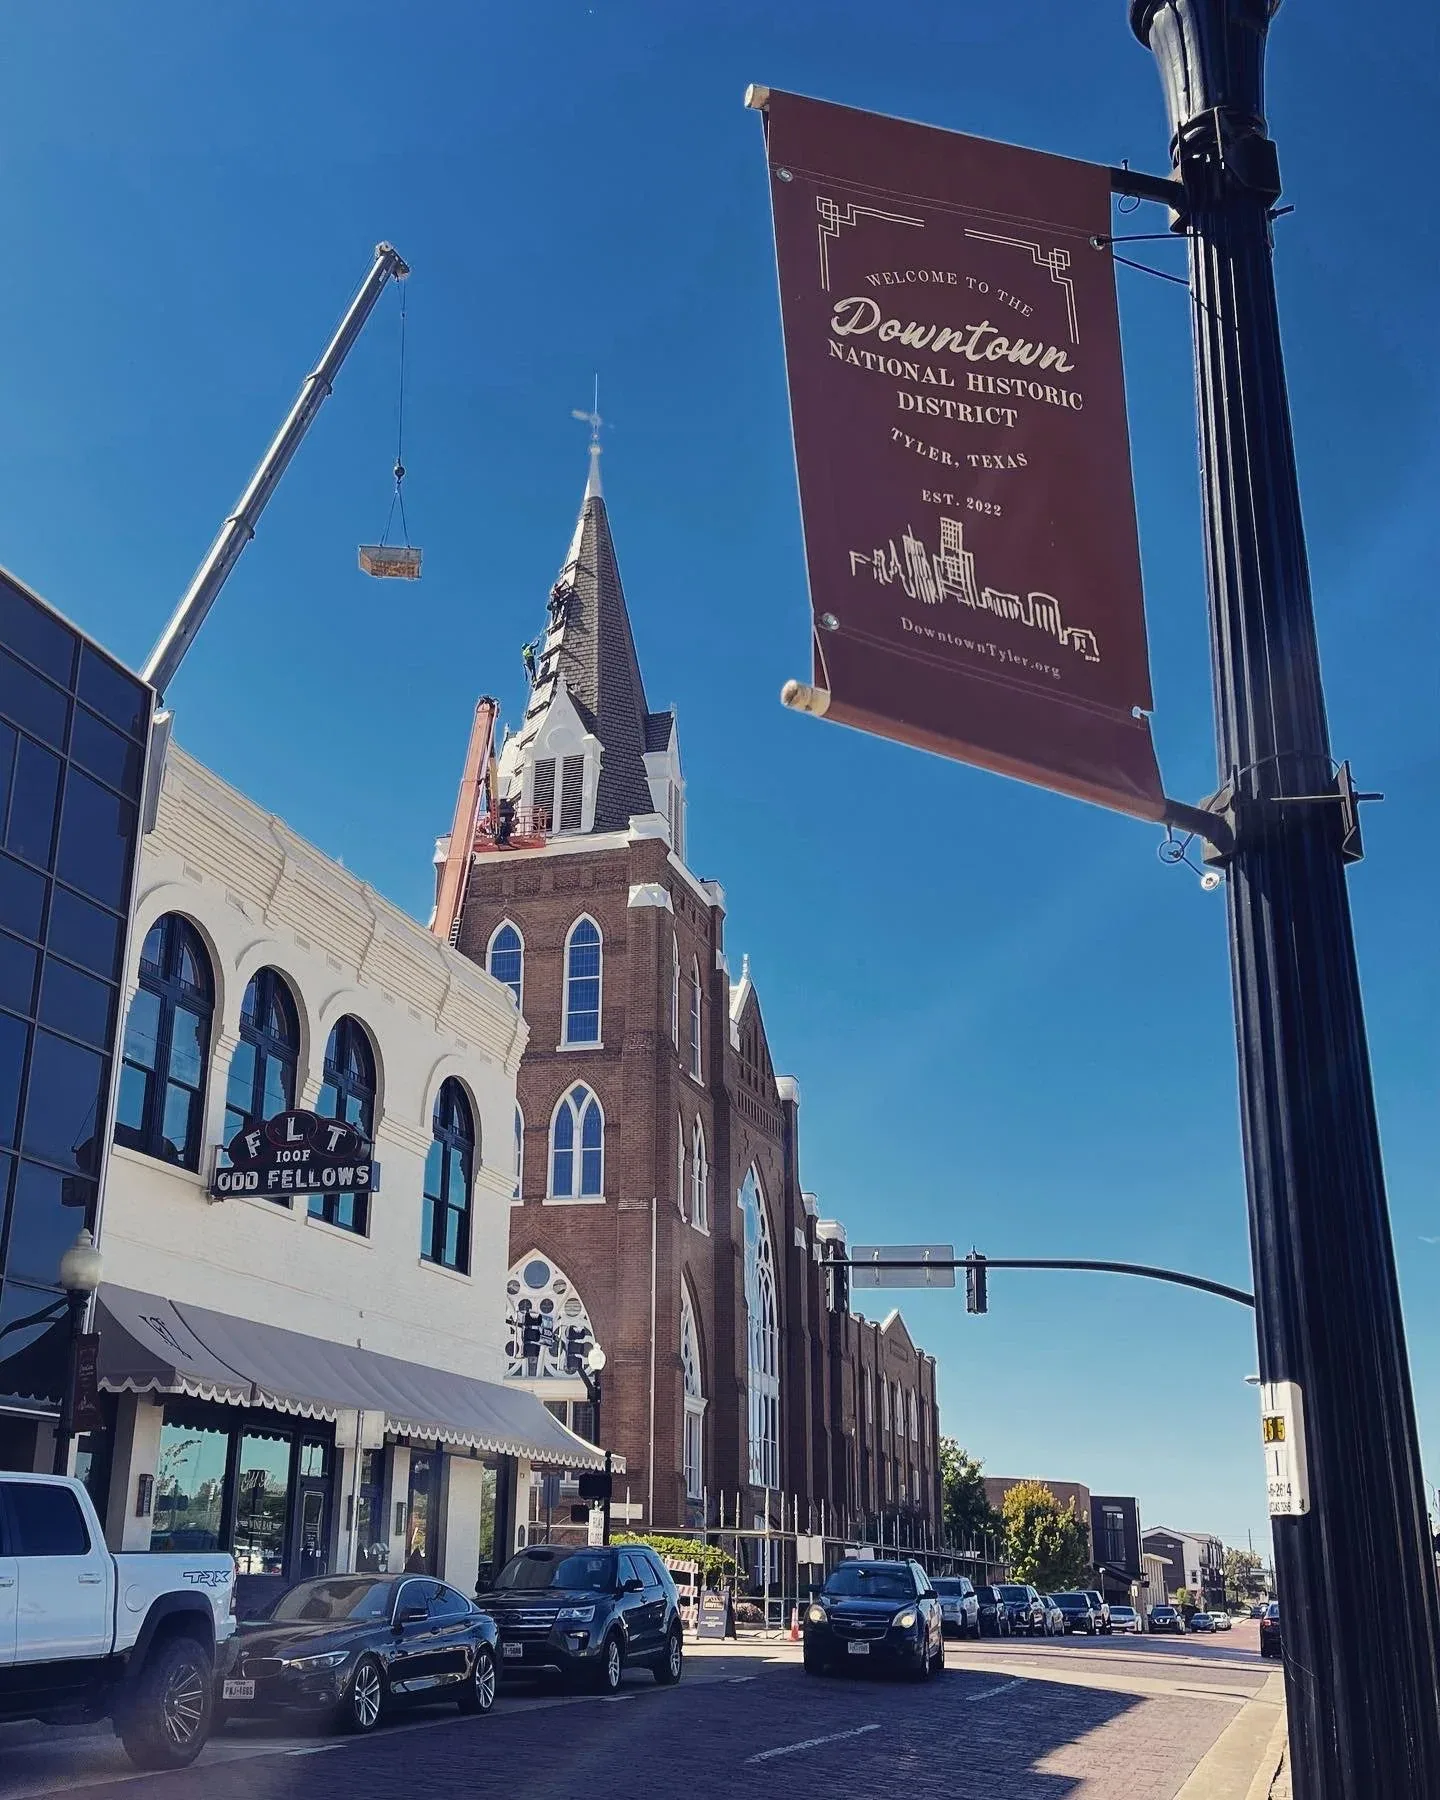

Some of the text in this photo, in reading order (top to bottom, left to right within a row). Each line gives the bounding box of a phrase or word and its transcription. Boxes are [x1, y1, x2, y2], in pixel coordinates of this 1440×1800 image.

[865, 270, 1034, 318] WELCOME TO THE
[831, 296, 1075, 373] Downtown
[828, 339, 1084, 411] NATIONAL HISTORIC
[897, 391, 1018, 428] DISTRICT
[891, 427, 1029, 470] TYLER, TEXAS
[922, 489, 1002, 517] EST. 2022
[901, 616, 1062, 680] DowntownTyler.org
[217, 1165, 369, 1191] ODD FELLOWS
[183, 1570, 231, 1586] TRX
